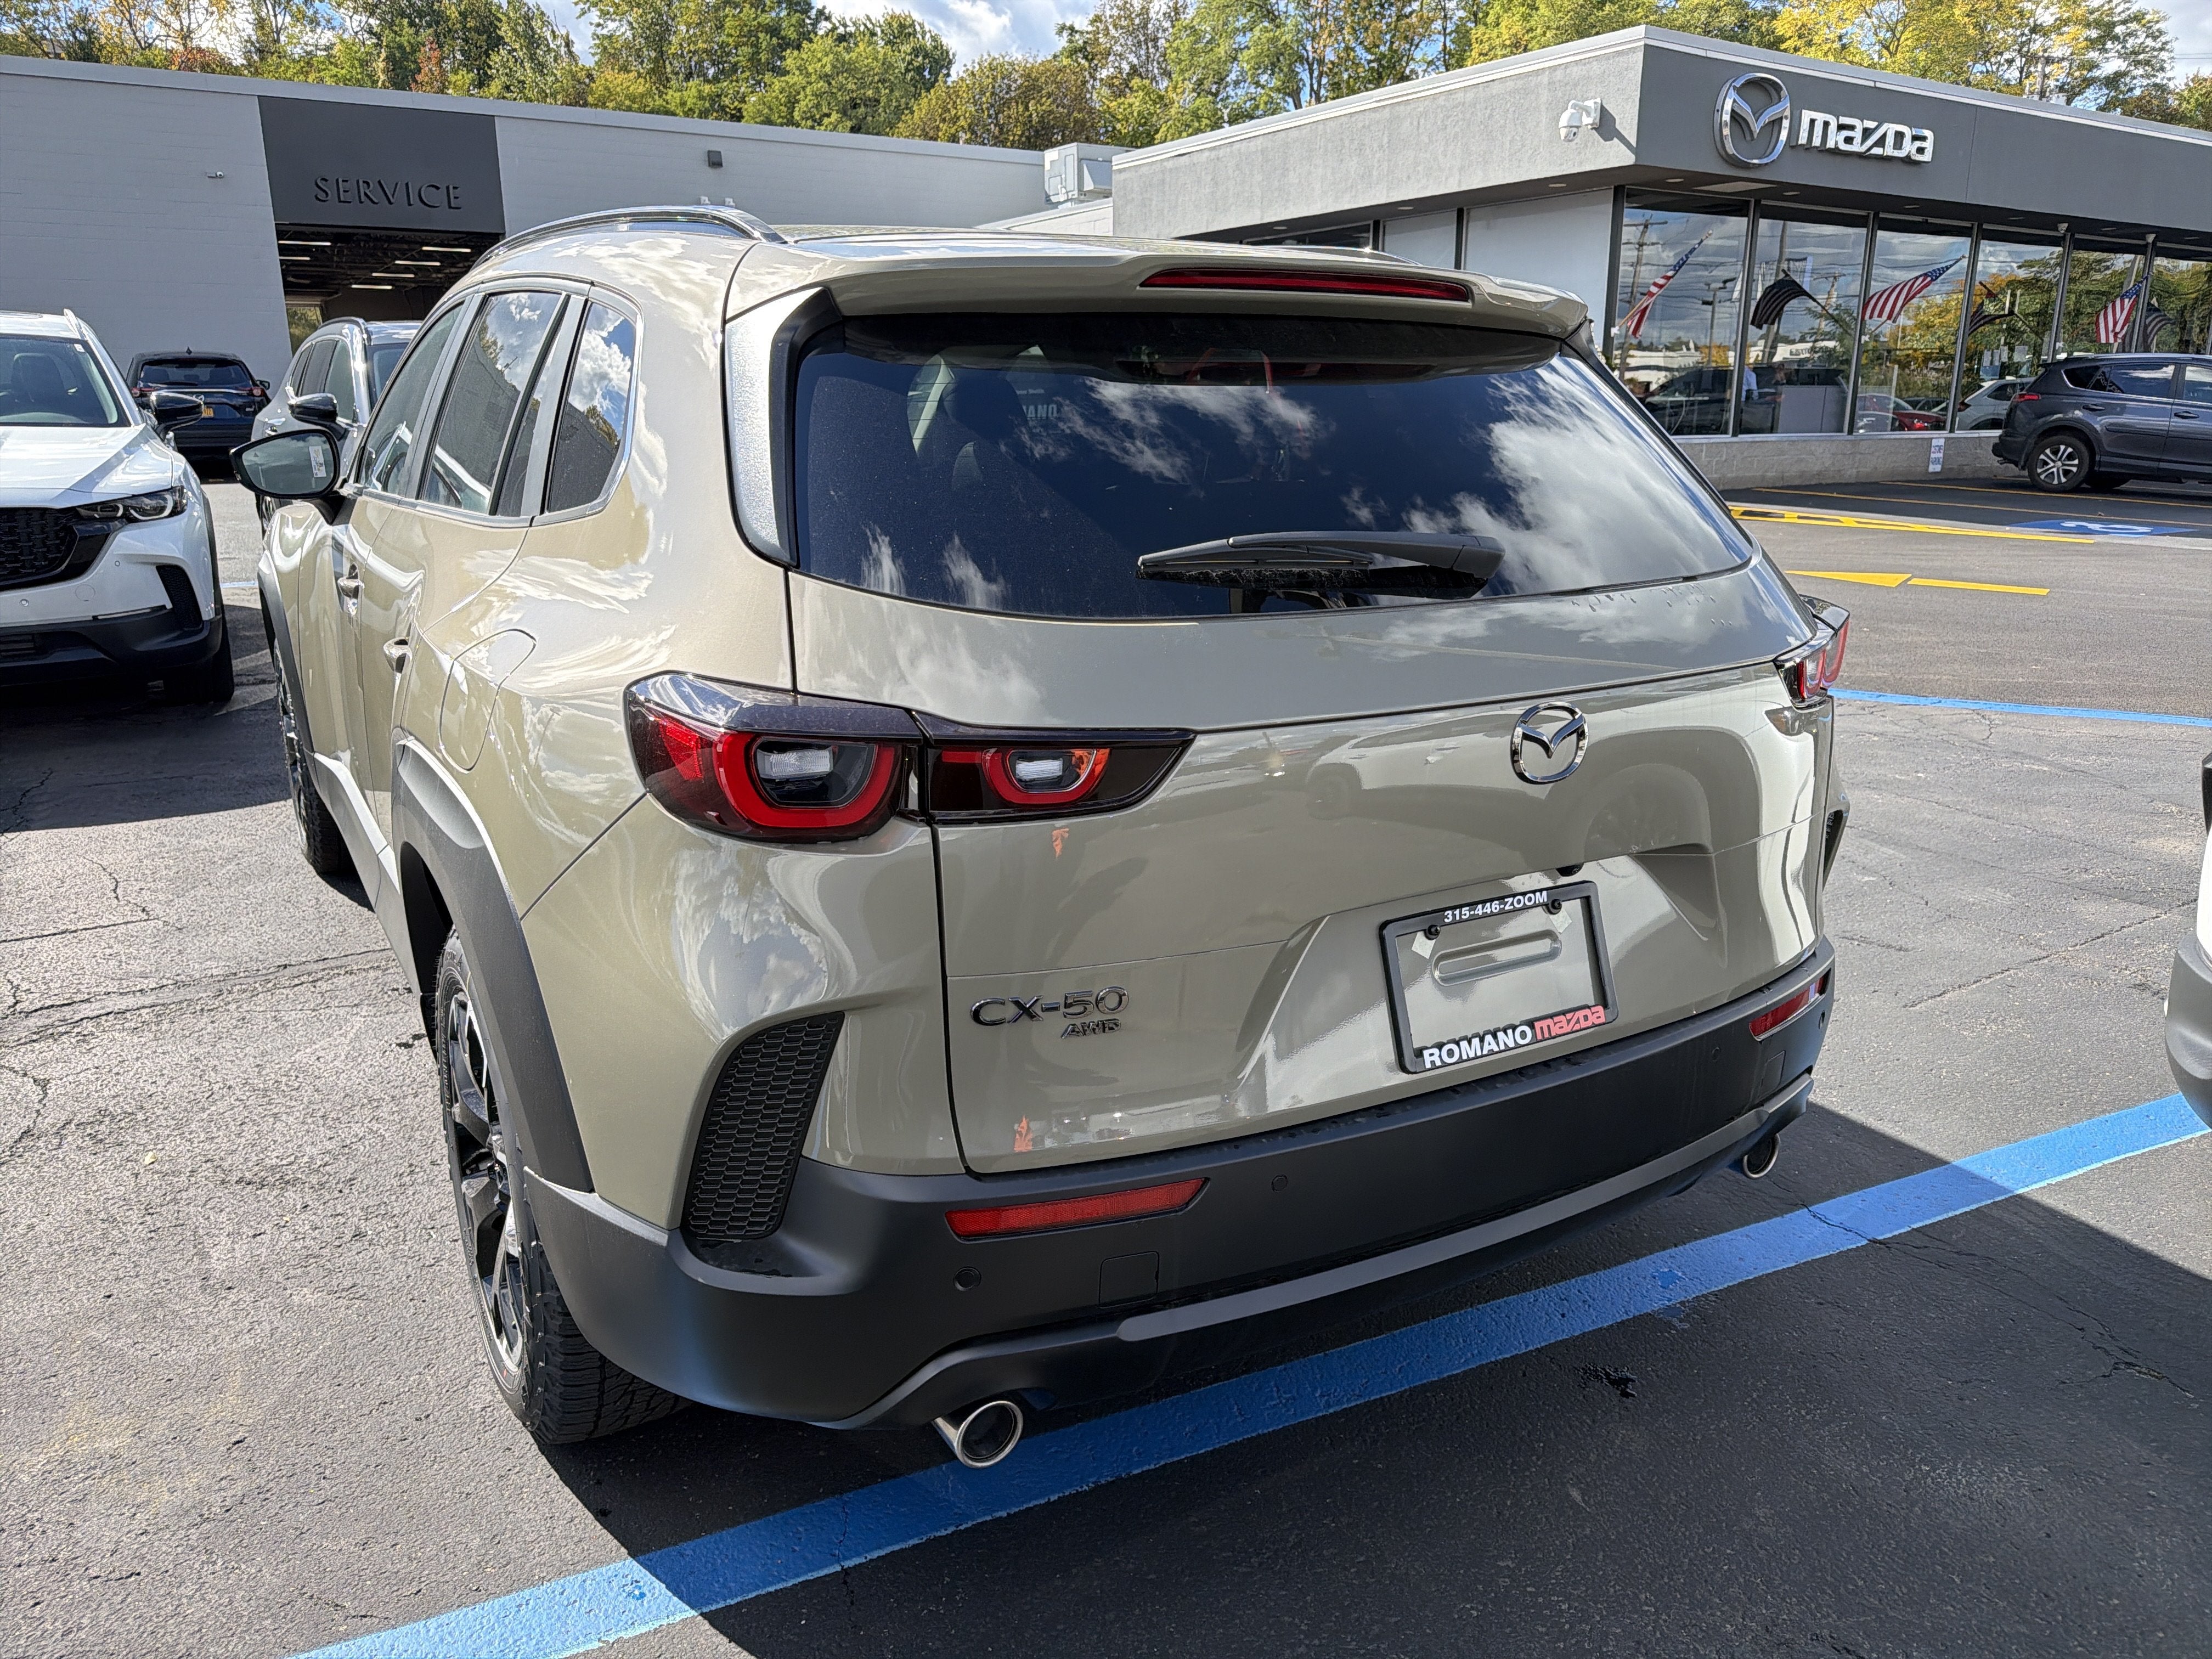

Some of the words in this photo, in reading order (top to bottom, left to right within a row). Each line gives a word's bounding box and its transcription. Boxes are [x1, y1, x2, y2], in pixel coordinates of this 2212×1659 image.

[1798, 108, 1934, 163] mazda
[314, 176, 462, 210] SERVICE
[1443, 890, 1548, 923] 315-446-ZOOM
[970, 985, 1130, 1026] CX-50
[1060, 1018, 1122, 1039] AWD
[1423, 1025, 1533, 1069] ROMANO
[1533, 1005, 1606, 1041] mazda
